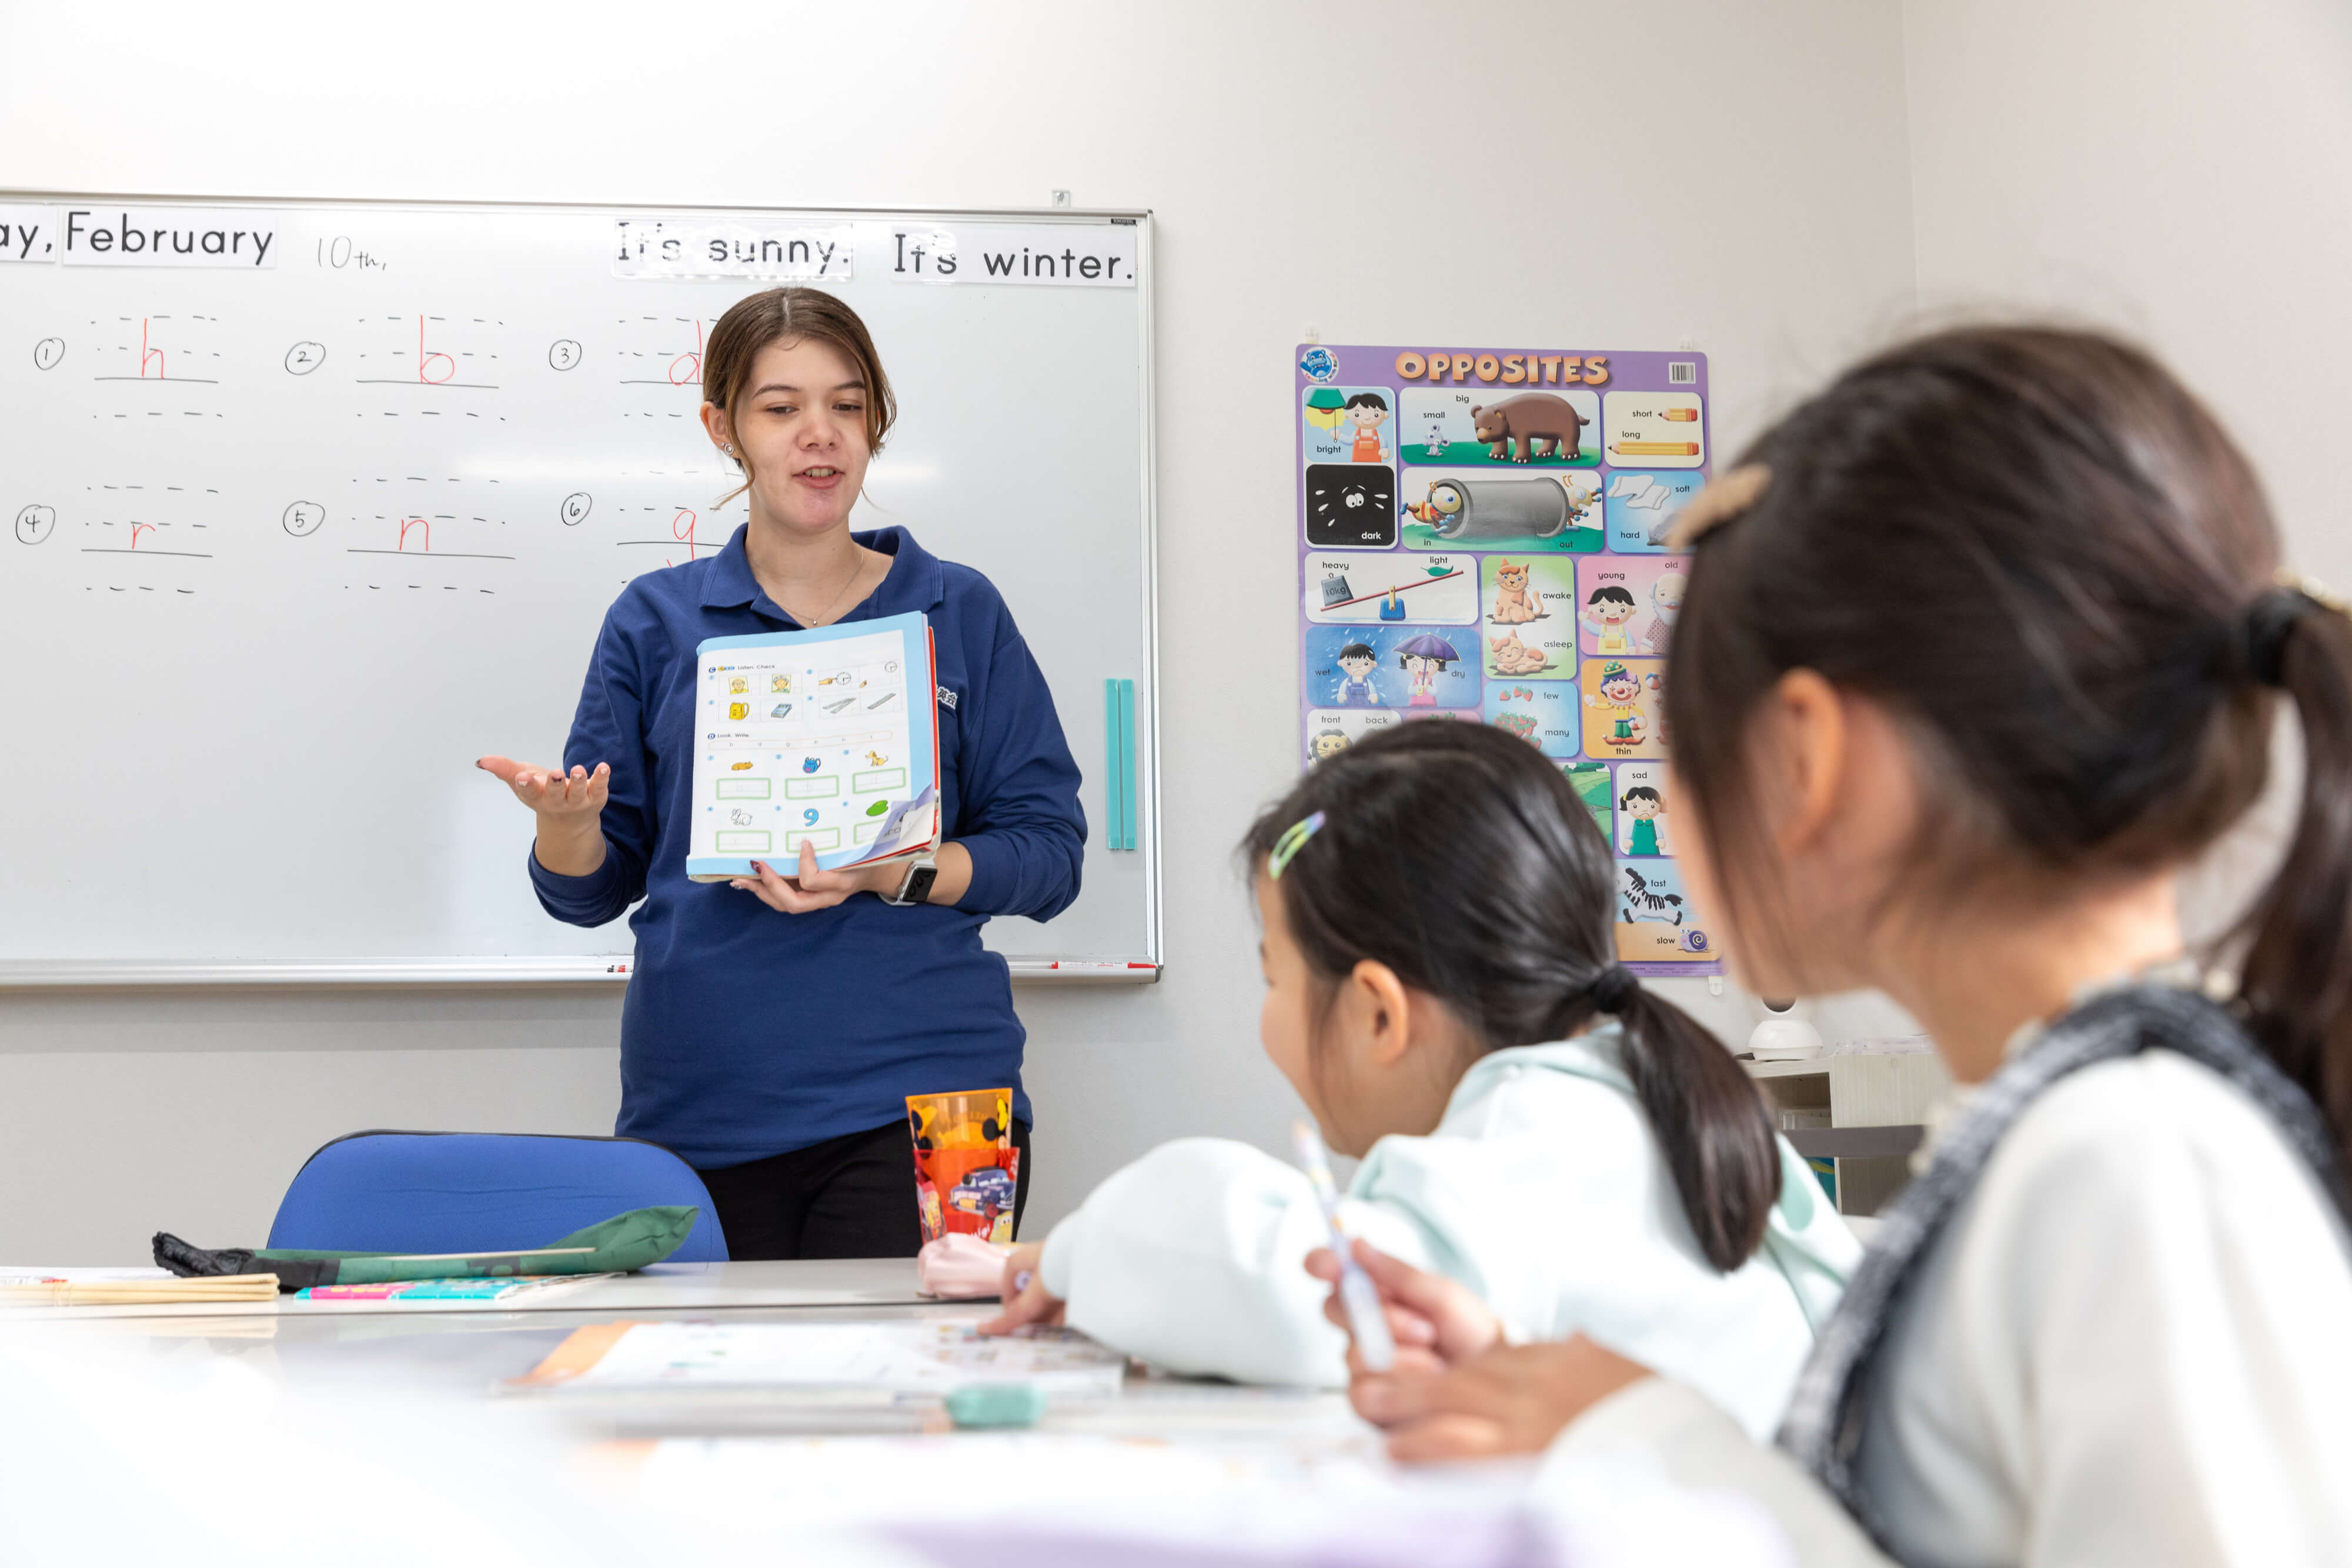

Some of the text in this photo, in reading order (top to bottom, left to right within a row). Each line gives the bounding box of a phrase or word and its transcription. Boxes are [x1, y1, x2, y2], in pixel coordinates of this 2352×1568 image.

[67, 211, 273, 266] February
[709, 239, 848, 275] sunny.
[894, 233, 1132, 279] It's winter.
[1395, 351, 1609, 385] OPPOSITES
[1456, 394, 1469, 404] big
[1622, 430, 1641, 440] long
[1317, 445, 1341, 454] bright
[1675, 484, 1690, 493] soft
[1361, 531, 1381, 540] dark
[1559, 540, 1573, 549] out
[1429, 556, 1448, 565] light
[1322, 561, 1349, 571] heavy
[1598, 573, 1625, 581] young
[1325, 586, 1347, 597] 10kg
[1544, 640, 1572, 649] asleep
[1315, 667, 1332, 676] wet
[1451, 669, 1465, 679] dry
[938, 687, 956, 707] 英会
[1544, 691, 1559, 700] few
[1321, 716, 1341, 724] front
[1545, 730, 1570, 739] many
[803, 808, 819, 827] 9
[1651, 879, 1666, 887] fast
